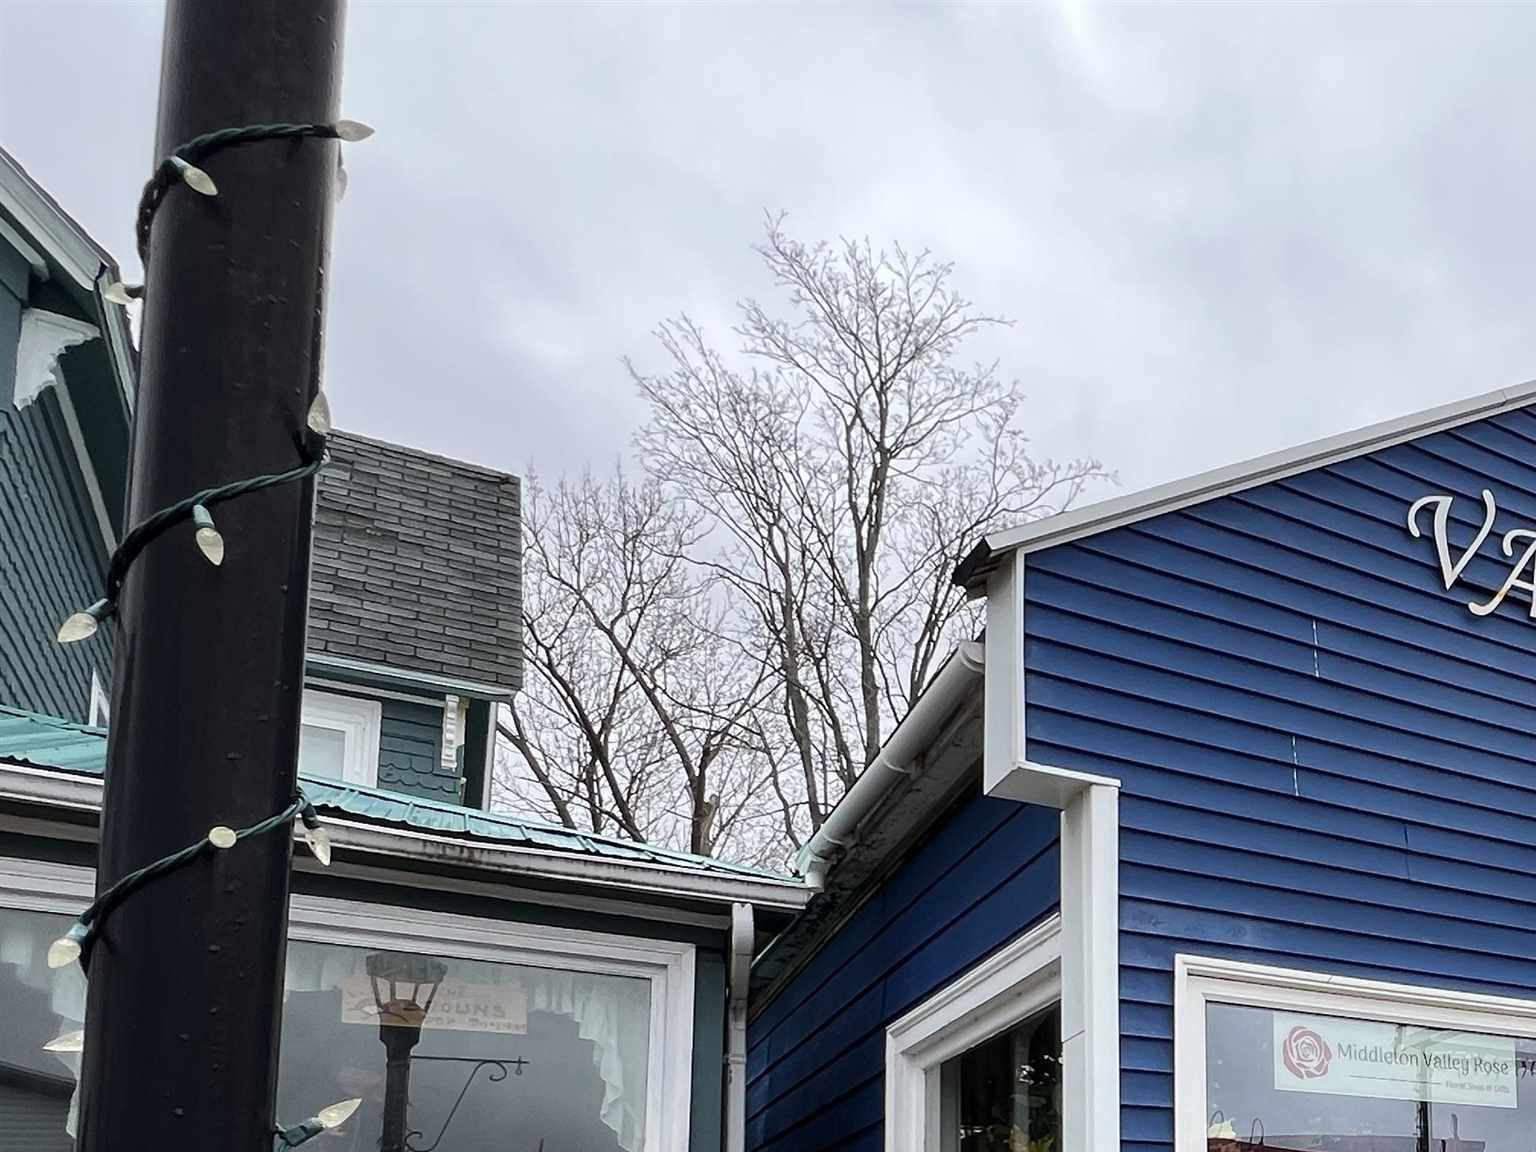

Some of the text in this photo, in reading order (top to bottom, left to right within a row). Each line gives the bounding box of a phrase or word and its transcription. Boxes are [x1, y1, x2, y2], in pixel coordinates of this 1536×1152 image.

[1337, 1043, 1509, 1076] Middleton Valley Rose
